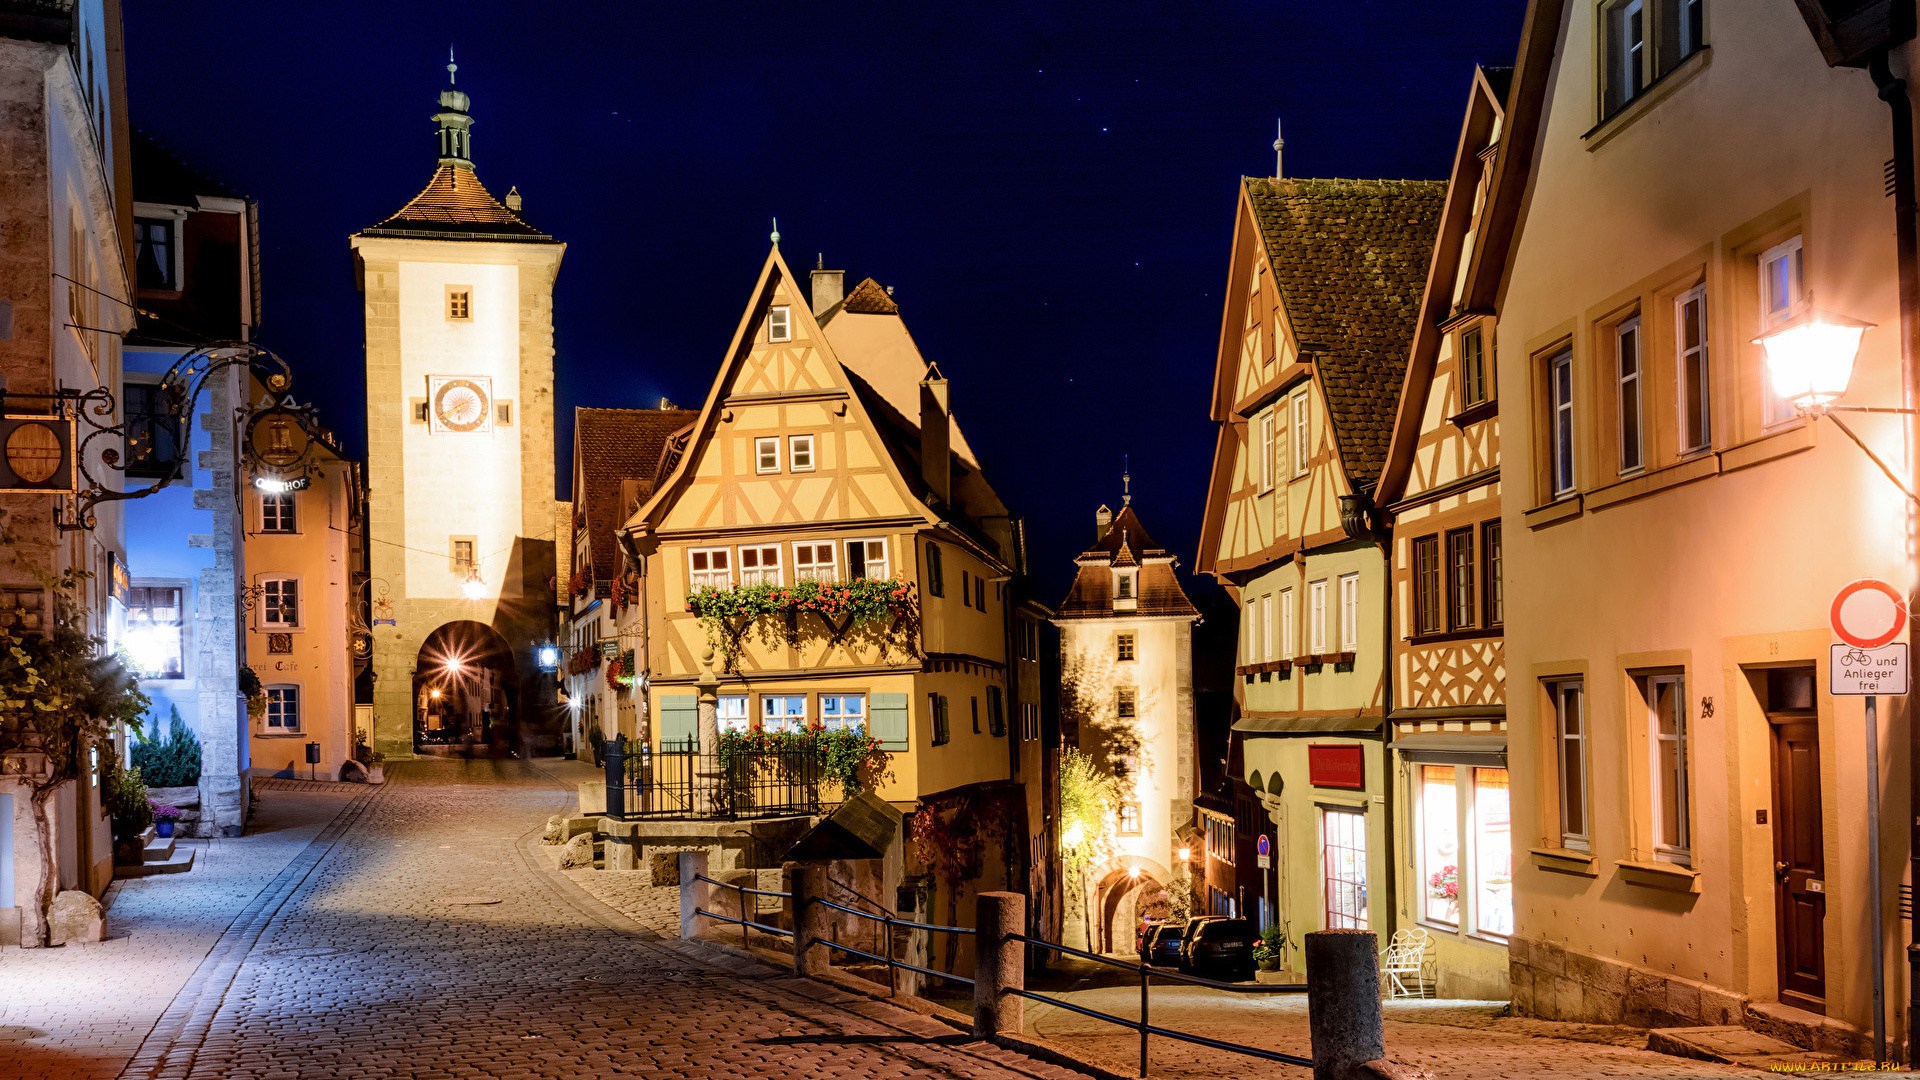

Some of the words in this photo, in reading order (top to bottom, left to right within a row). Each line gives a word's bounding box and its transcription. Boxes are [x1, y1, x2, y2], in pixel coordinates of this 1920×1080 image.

[1768, 642, 1779, 655] 28
[1876, 657, 1898, 666] und
[1844, 669, 1894, 681] Anlieger
[1859, 681, 1879, 690] frei
[1701, 696, 1715, 719] 28
